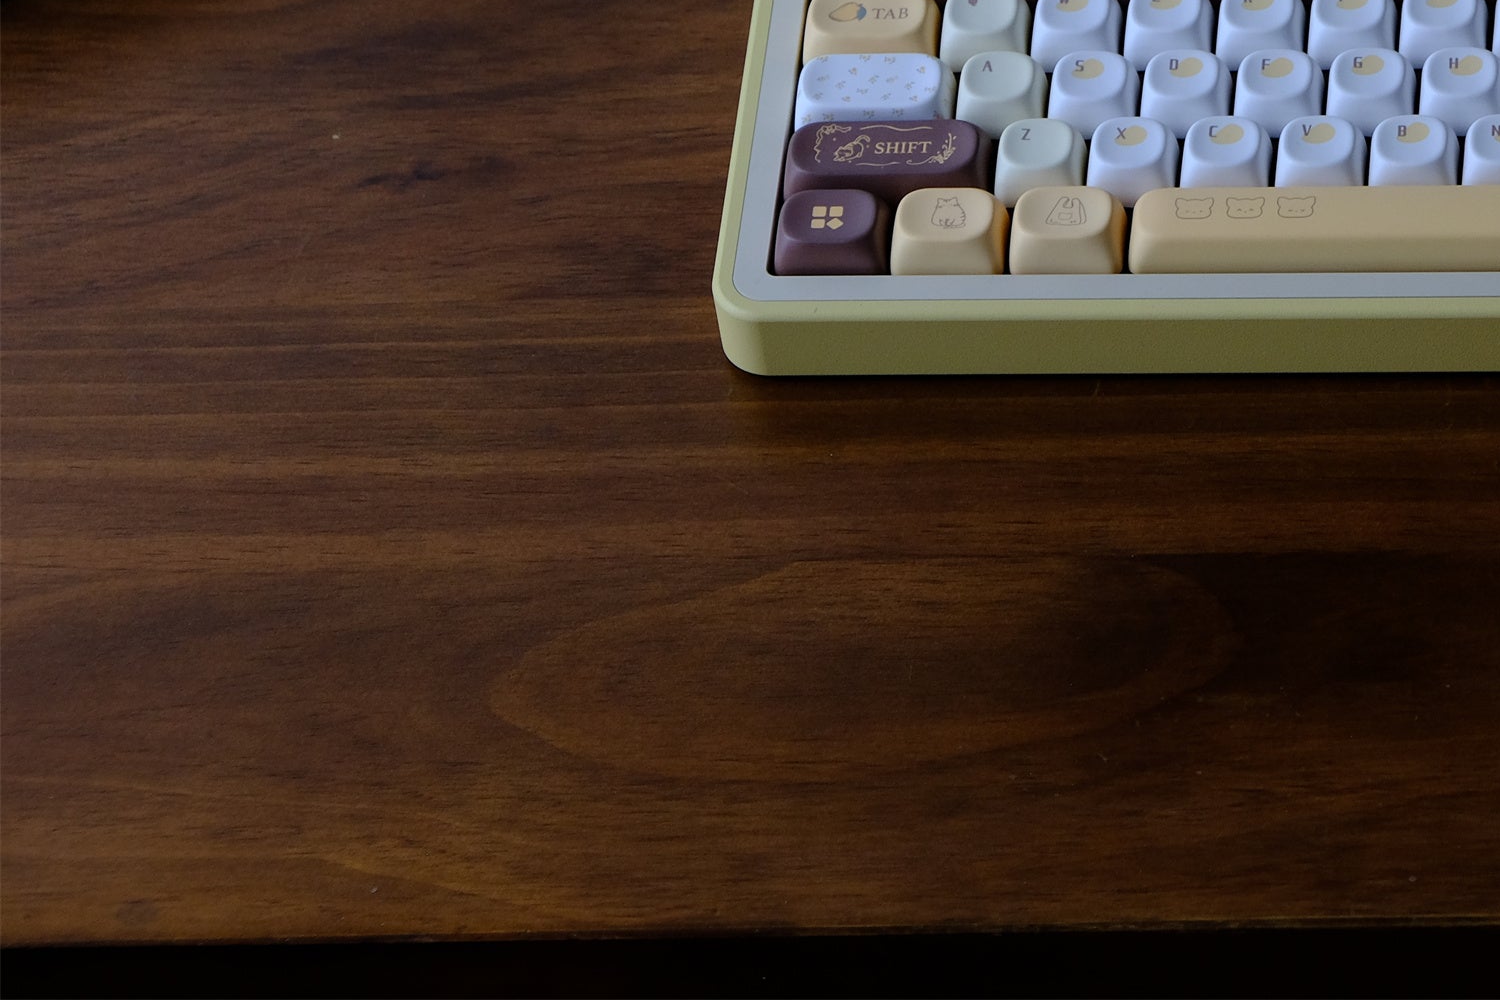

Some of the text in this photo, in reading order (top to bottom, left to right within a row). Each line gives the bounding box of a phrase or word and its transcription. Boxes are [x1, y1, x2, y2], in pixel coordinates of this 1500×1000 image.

[872, 7, 909, 19] TAB
[982, 60, 993, 72] A
[1075, 60, 1084, 72] S
[1169, 59, 1178, 71] D
[1261, 59, 1271, 70] F
[1353, 57, 1363, 69] G
[1449, 58, 1459, 69] H
[1021, 128, 1031, 140] Z
[1117, 128, 1127, 139] X
[1209, 125, 1218, 138] C
[1302, 125, 1312, 136] V
[1398, 125, 1407, 136] B
[874, 141, 932, 155] SHIFT
